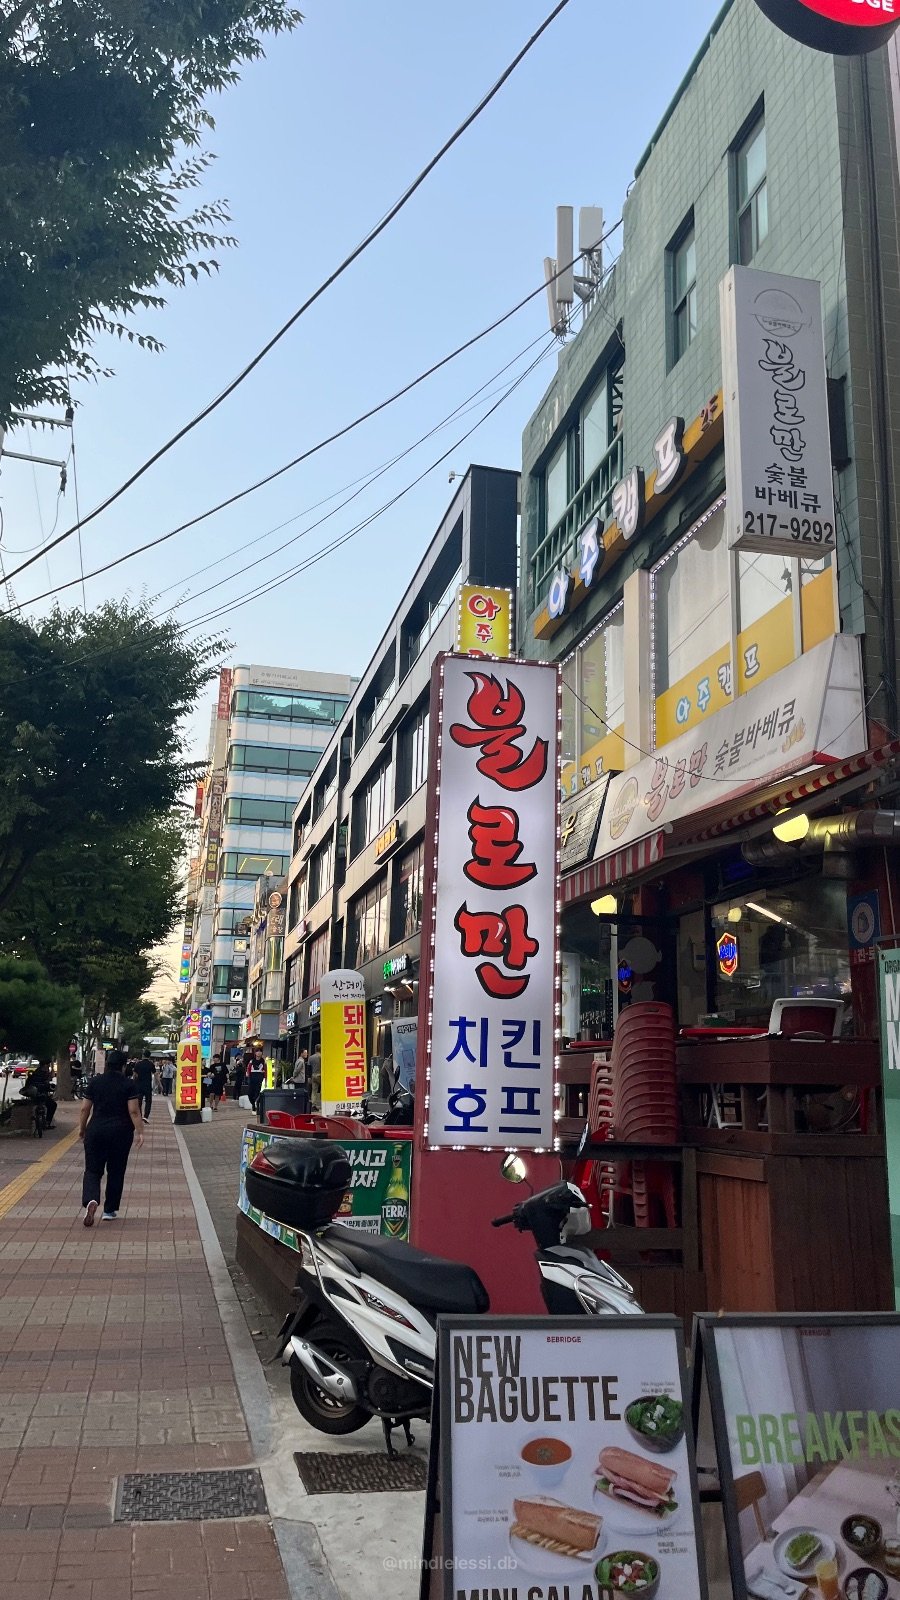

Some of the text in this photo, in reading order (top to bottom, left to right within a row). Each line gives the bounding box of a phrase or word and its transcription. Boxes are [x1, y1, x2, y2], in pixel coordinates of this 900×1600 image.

[755, 486, 821, 514] 바베큐
[764, 463, 808, 489] 숯불
[548, 416, 684, 620] 아주캠프
[744, 511, 834, 545] 217-9292
[713, 698, 798, 775] 숯불바베큐
[201, 1015, 212, 1042] GS25
[343, 1004, 366, 1098] 돼지국밥
[446, 1016, 542, 1069] 치킨
[180, 1044, 199, 1105] 사진관
[444, 1084, 542, 1134] 호프
[382, 1205, 407, 1218] TERRA
[454, 1335, 521, 1377] NEW
[454, 1375, 621, 1423] BAGUETTE
